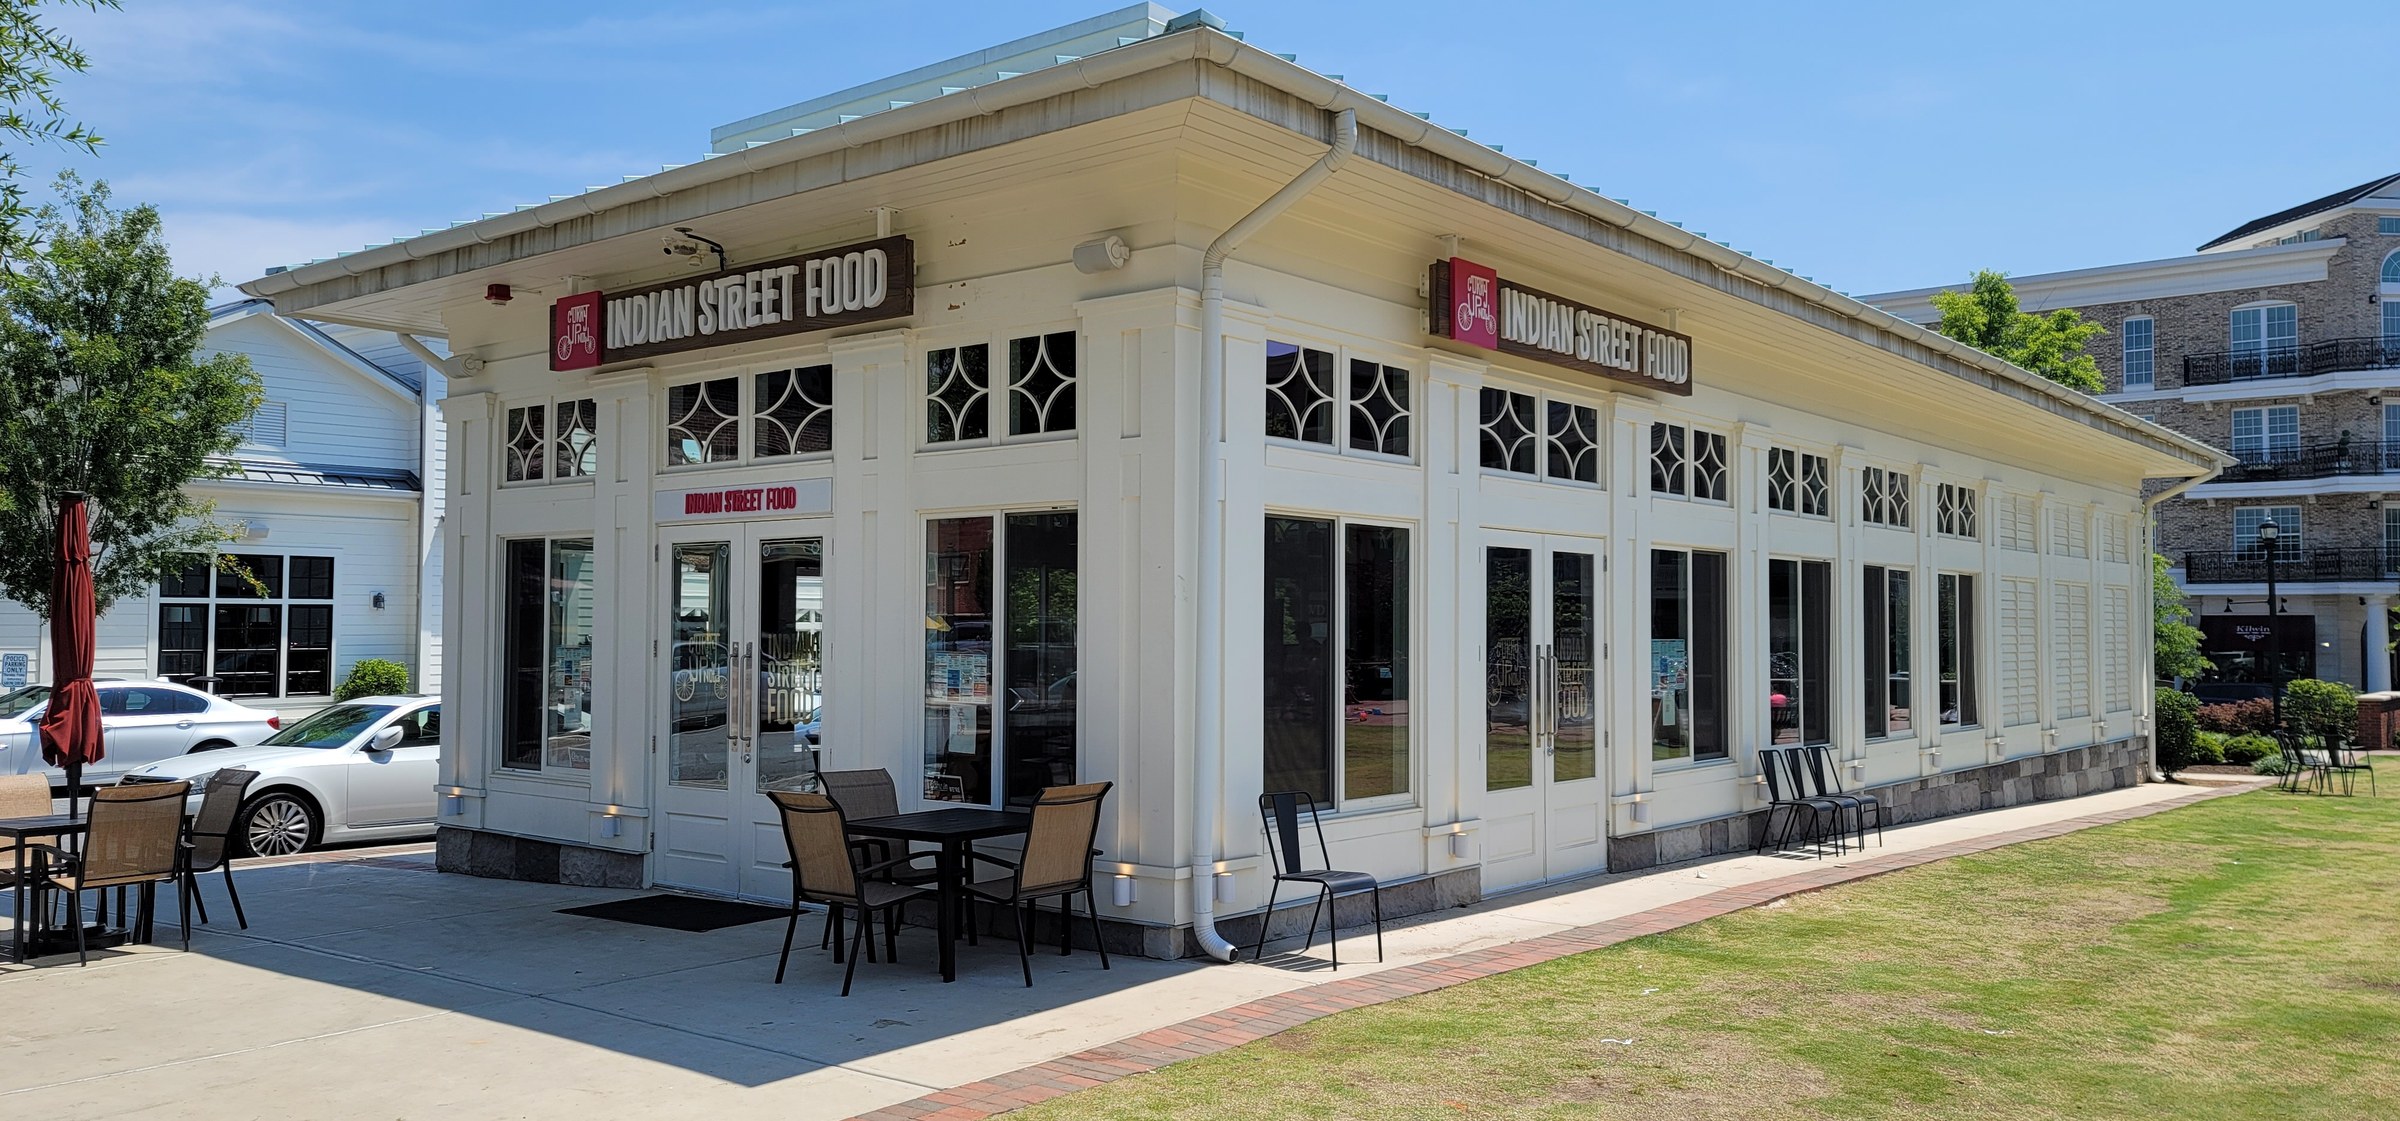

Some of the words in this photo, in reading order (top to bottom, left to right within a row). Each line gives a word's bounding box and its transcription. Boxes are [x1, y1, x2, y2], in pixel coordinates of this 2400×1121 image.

[606, 285, 696, 350] INDIAN
[698, 265, 800, 336] STREET
[805, 248, 888, 318] FOOD
[1467, 293, 1483, 319] UP
[567, 323, 582, 345] UP
[1500, 287, 1575, 356] INDIAN
[1575, 310, 1643, 373] STREET
[1642, 329, 1689, 385] FOOD
[685, 492, 723, 514] INDIAN
[724, 489, 764, 513] STREET
[766, 486, 797, 510] FOOD
[767, 688, 814, 725] FOOD
